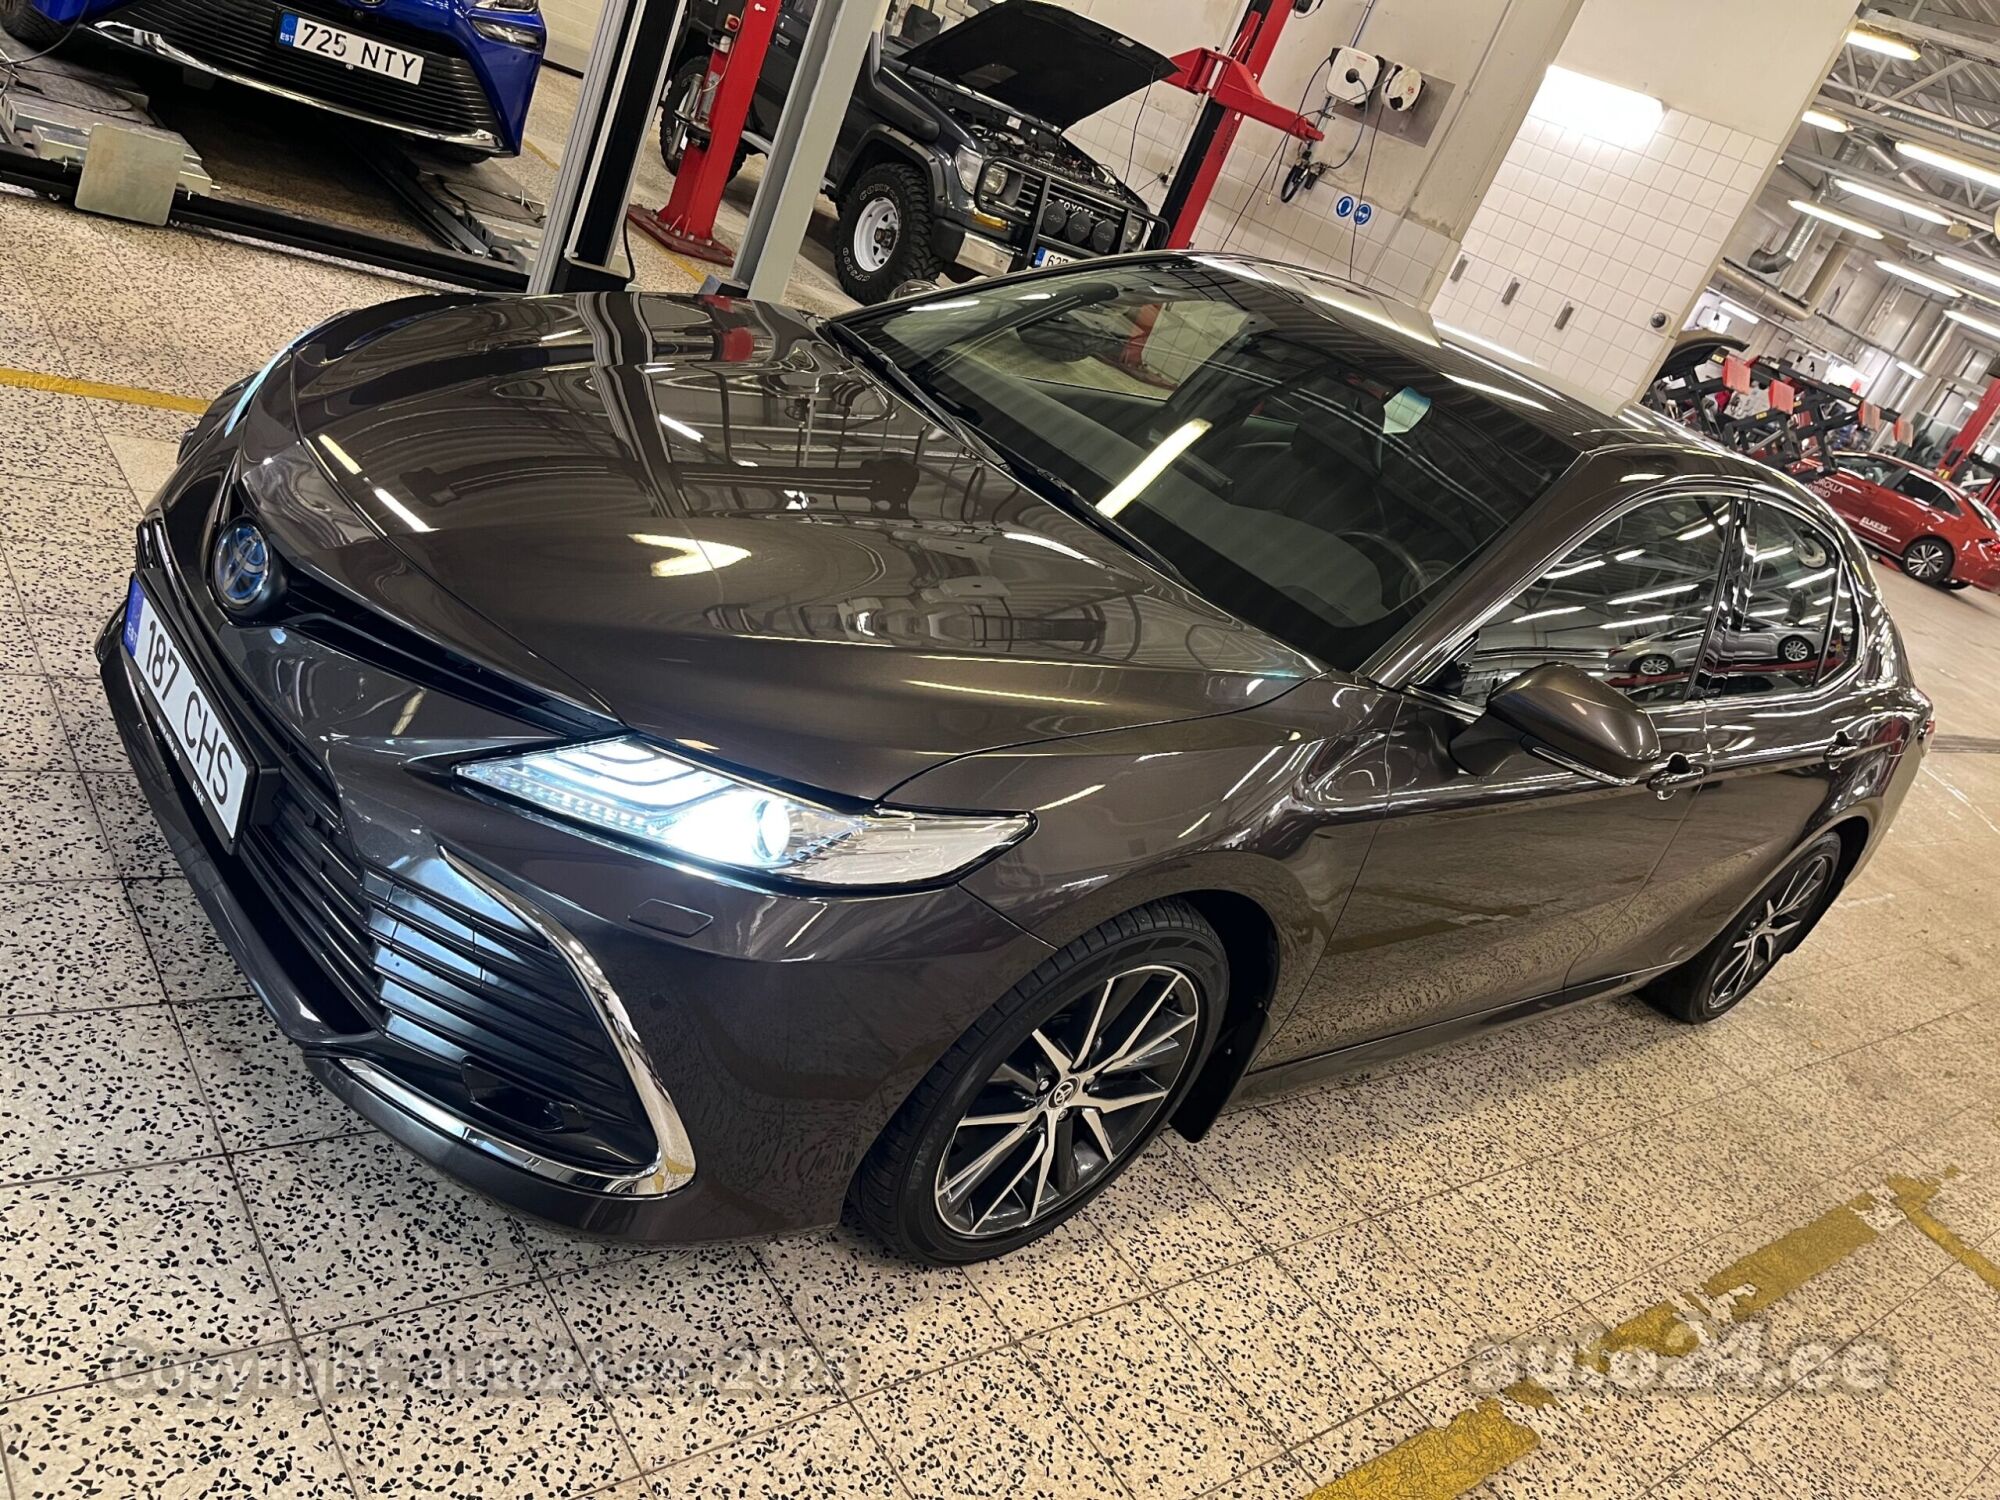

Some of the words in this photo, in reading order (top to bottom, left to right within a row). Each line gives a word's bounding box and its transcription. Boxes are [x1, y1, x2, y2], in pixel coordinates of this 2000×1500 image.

[280, 32, 295, 43] EST
[301, 23, 347, 57] 725
[361, 42, 417, 78] NTY
[146, 619, 180, 701] 187
[184, 690, 233, 806] CHS
